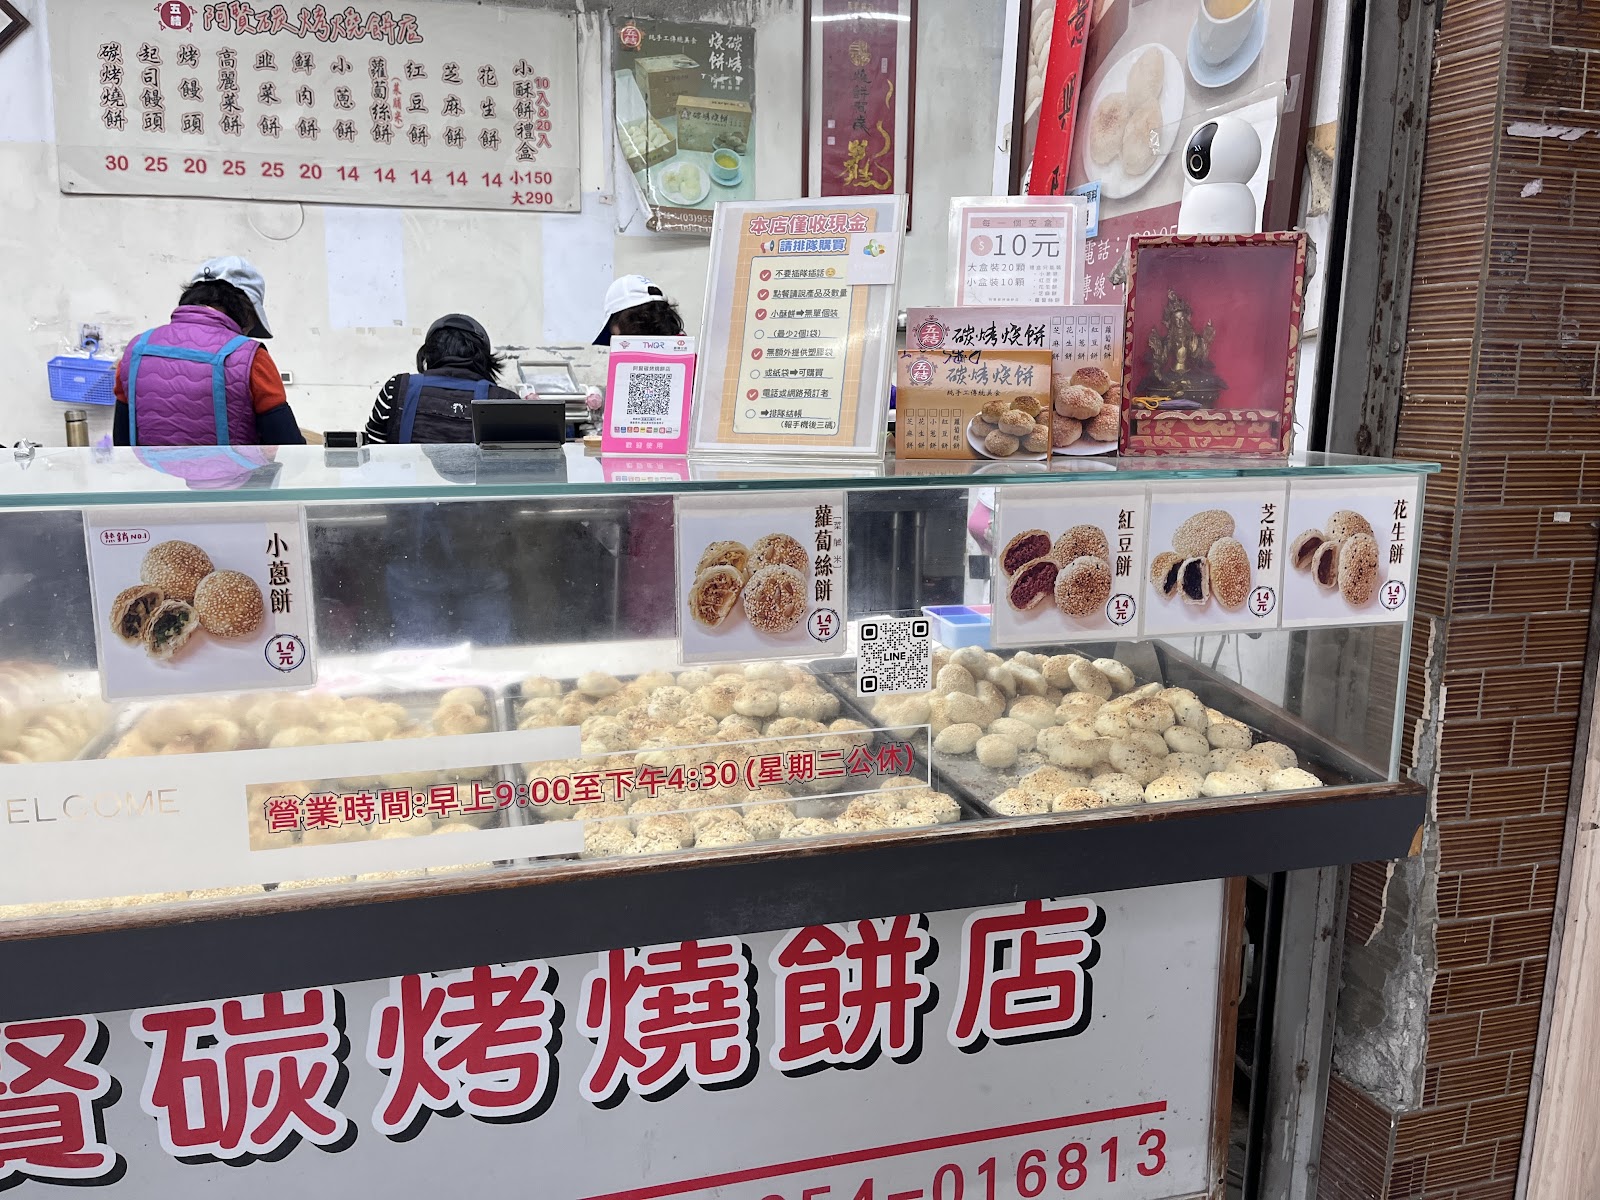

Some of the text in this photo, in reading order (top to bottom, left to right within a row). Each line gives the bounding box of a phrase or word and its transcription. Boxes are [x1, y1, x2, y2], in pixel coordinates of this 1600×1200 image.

[100, 42, 127, 130] 碳烤燒餅
[138, 43, 165, 132] 起司饅頭
[177, 45, 204, 134] 烤饅頭
[217, 47, 244, 136] 高麗菜餅
[292, 52, 320, 140] 鮮肉餅
[369, 57, 393, 144] 蘿蔔絲餅
[442, 62, 466, 148] 芝麻餅
[478, 64, 501, 150] 花生餅
[514, 60, 537, 161] 小酥餅禮盒
[105, 155, 553, 188] 30 25 20 25 25 20 14 14 14 14 14 小150
[512, 191, 553, 205] 大290
[750, 213, 868, 235] 本店僅收現金
[780, 239, 845, 252] 請排隊購買
[982, 219, 1053, 228] 每一個空盒
[993, 233, 1060, 258] 10元
[966, 278, 1025, 287] 小盒裝10顆
[967, 263, 1026, 272] 大盒裝20顆
[643, 341, 665, 349] TWQR
[922, 325, 940, 345] 五結
[914, 362, 930, 380] 五結
[814, 504, 833, 601] 蘿蔔絲餅
[1115, 509, 1135, 577] 紅豆餅
[1257, 503, 1276, 570] 芝麻餅
[1389, 499, 1409, 564] 花生餅
[883, 652, 906, 661] LINE
